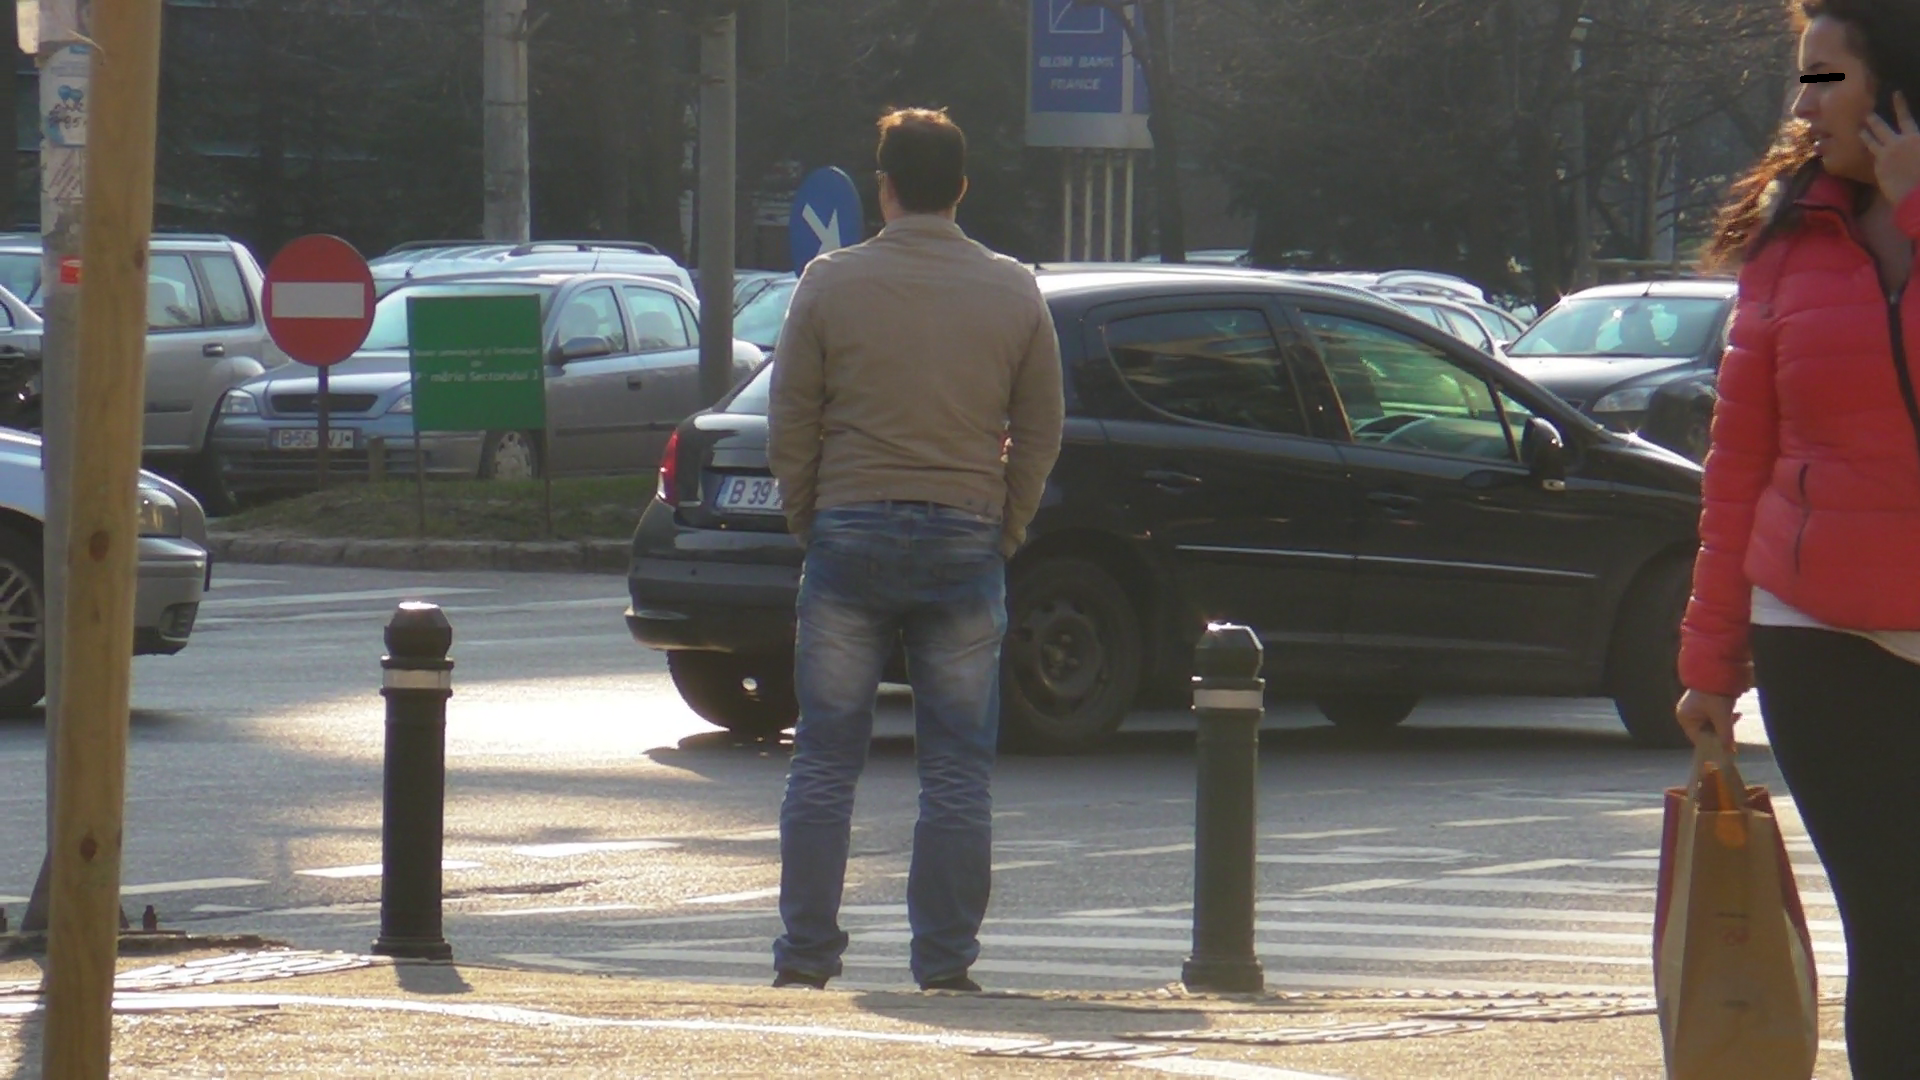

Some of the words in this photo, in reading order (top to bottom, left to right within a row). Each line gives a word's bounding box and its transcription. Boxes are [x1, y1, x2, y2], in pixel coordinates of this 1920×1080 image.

[1039, 56, 1073, 68] BLOM
[1078, 56, 1115, 68] BANK
[1050, 78, 1101, 90] FRANCE
[728, 480, 746, 504] B
[747, 481, 772, 505] 39
